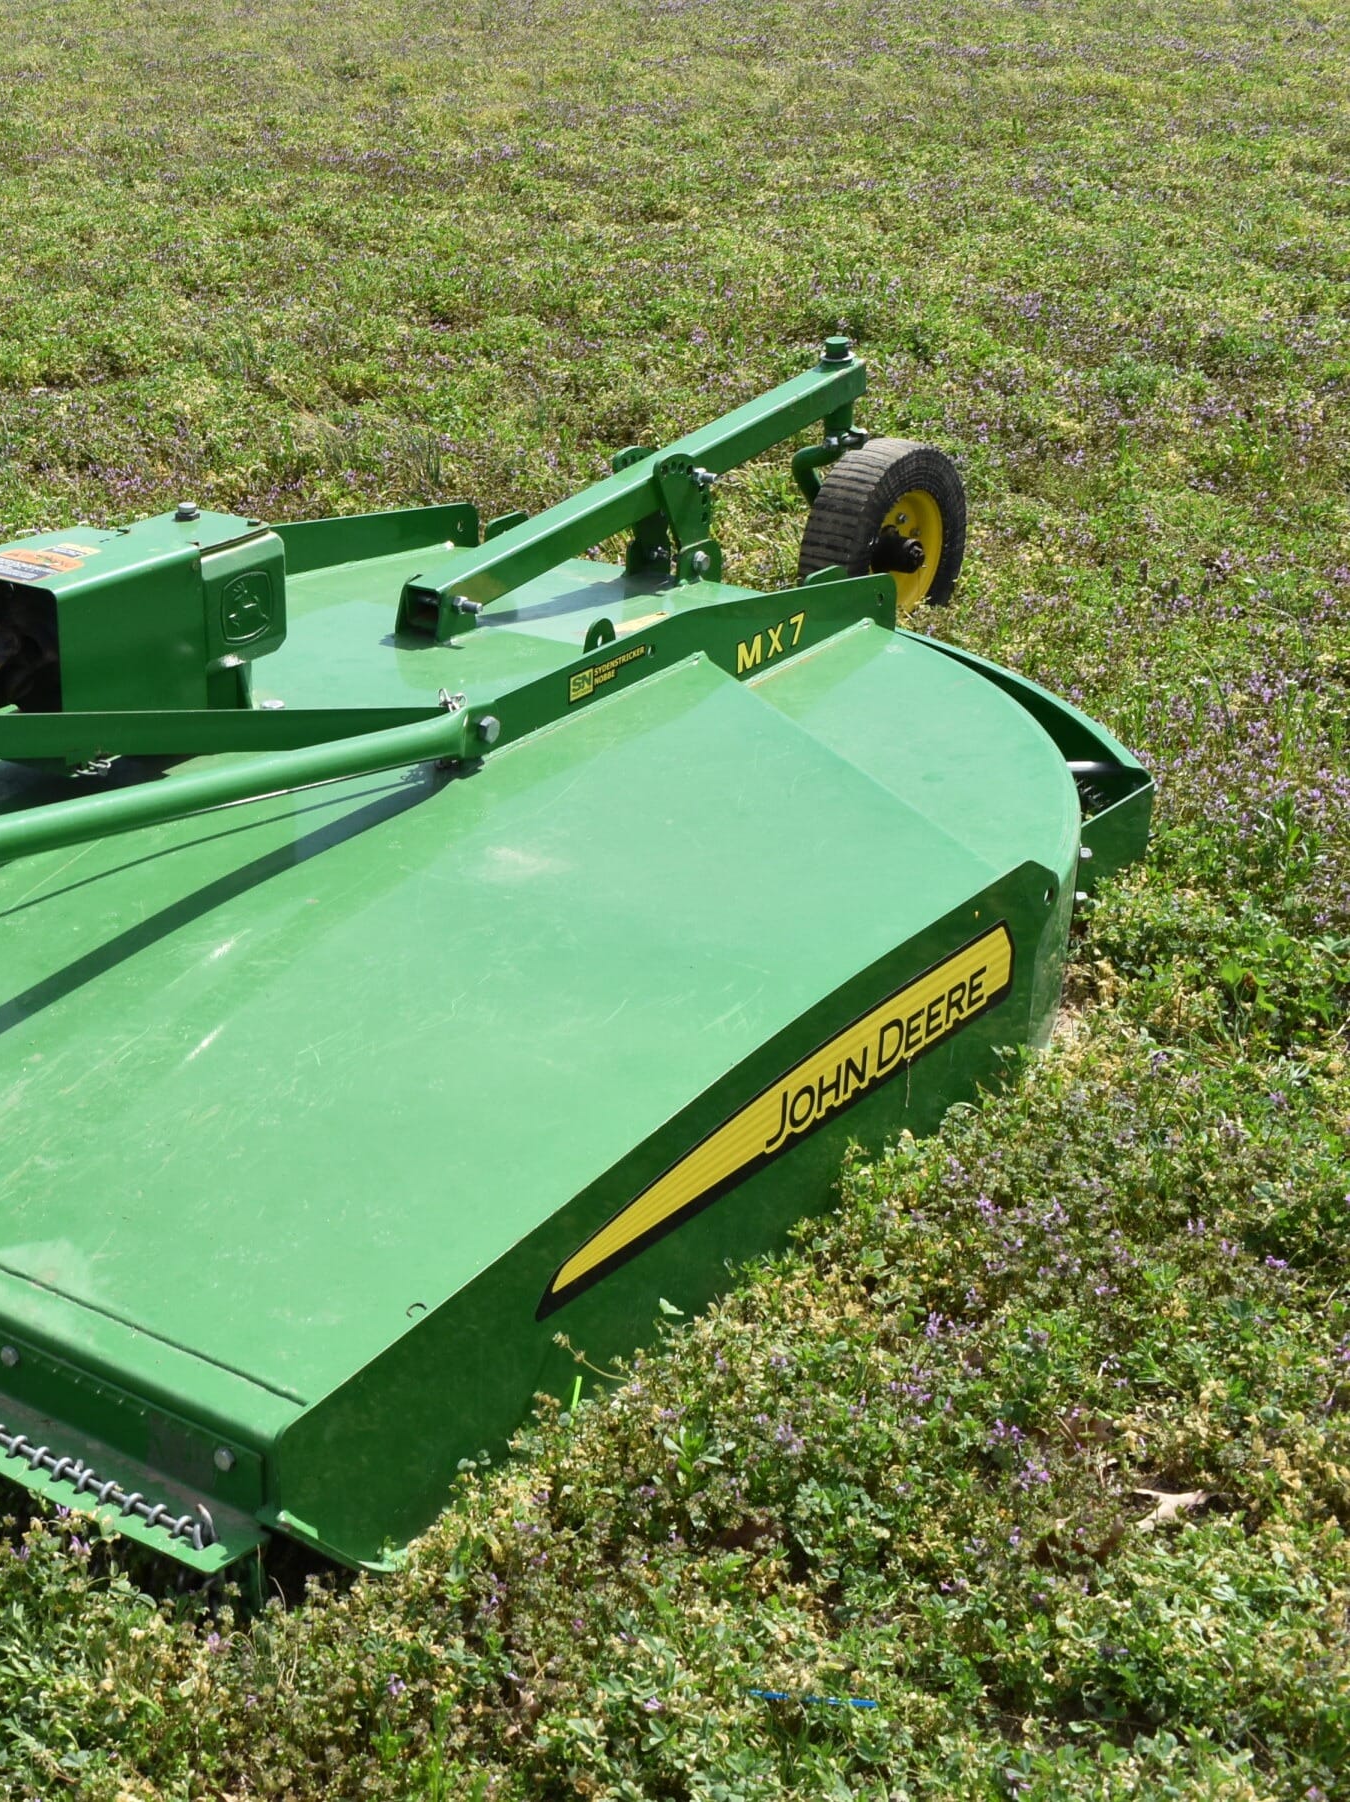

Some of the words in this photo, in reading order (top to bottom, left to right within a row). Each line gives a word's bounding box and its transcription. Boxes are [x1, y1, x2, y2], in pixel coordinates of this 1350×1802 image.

[594, 646, 645, 676] SYDENSTRICKER
[572, 672, 592, 692] SN
[594, 669, 616, 686] NOBBE
[765, 1046, 868, 1149] JOHN
[876, 965, 988, 1073] DEERE
